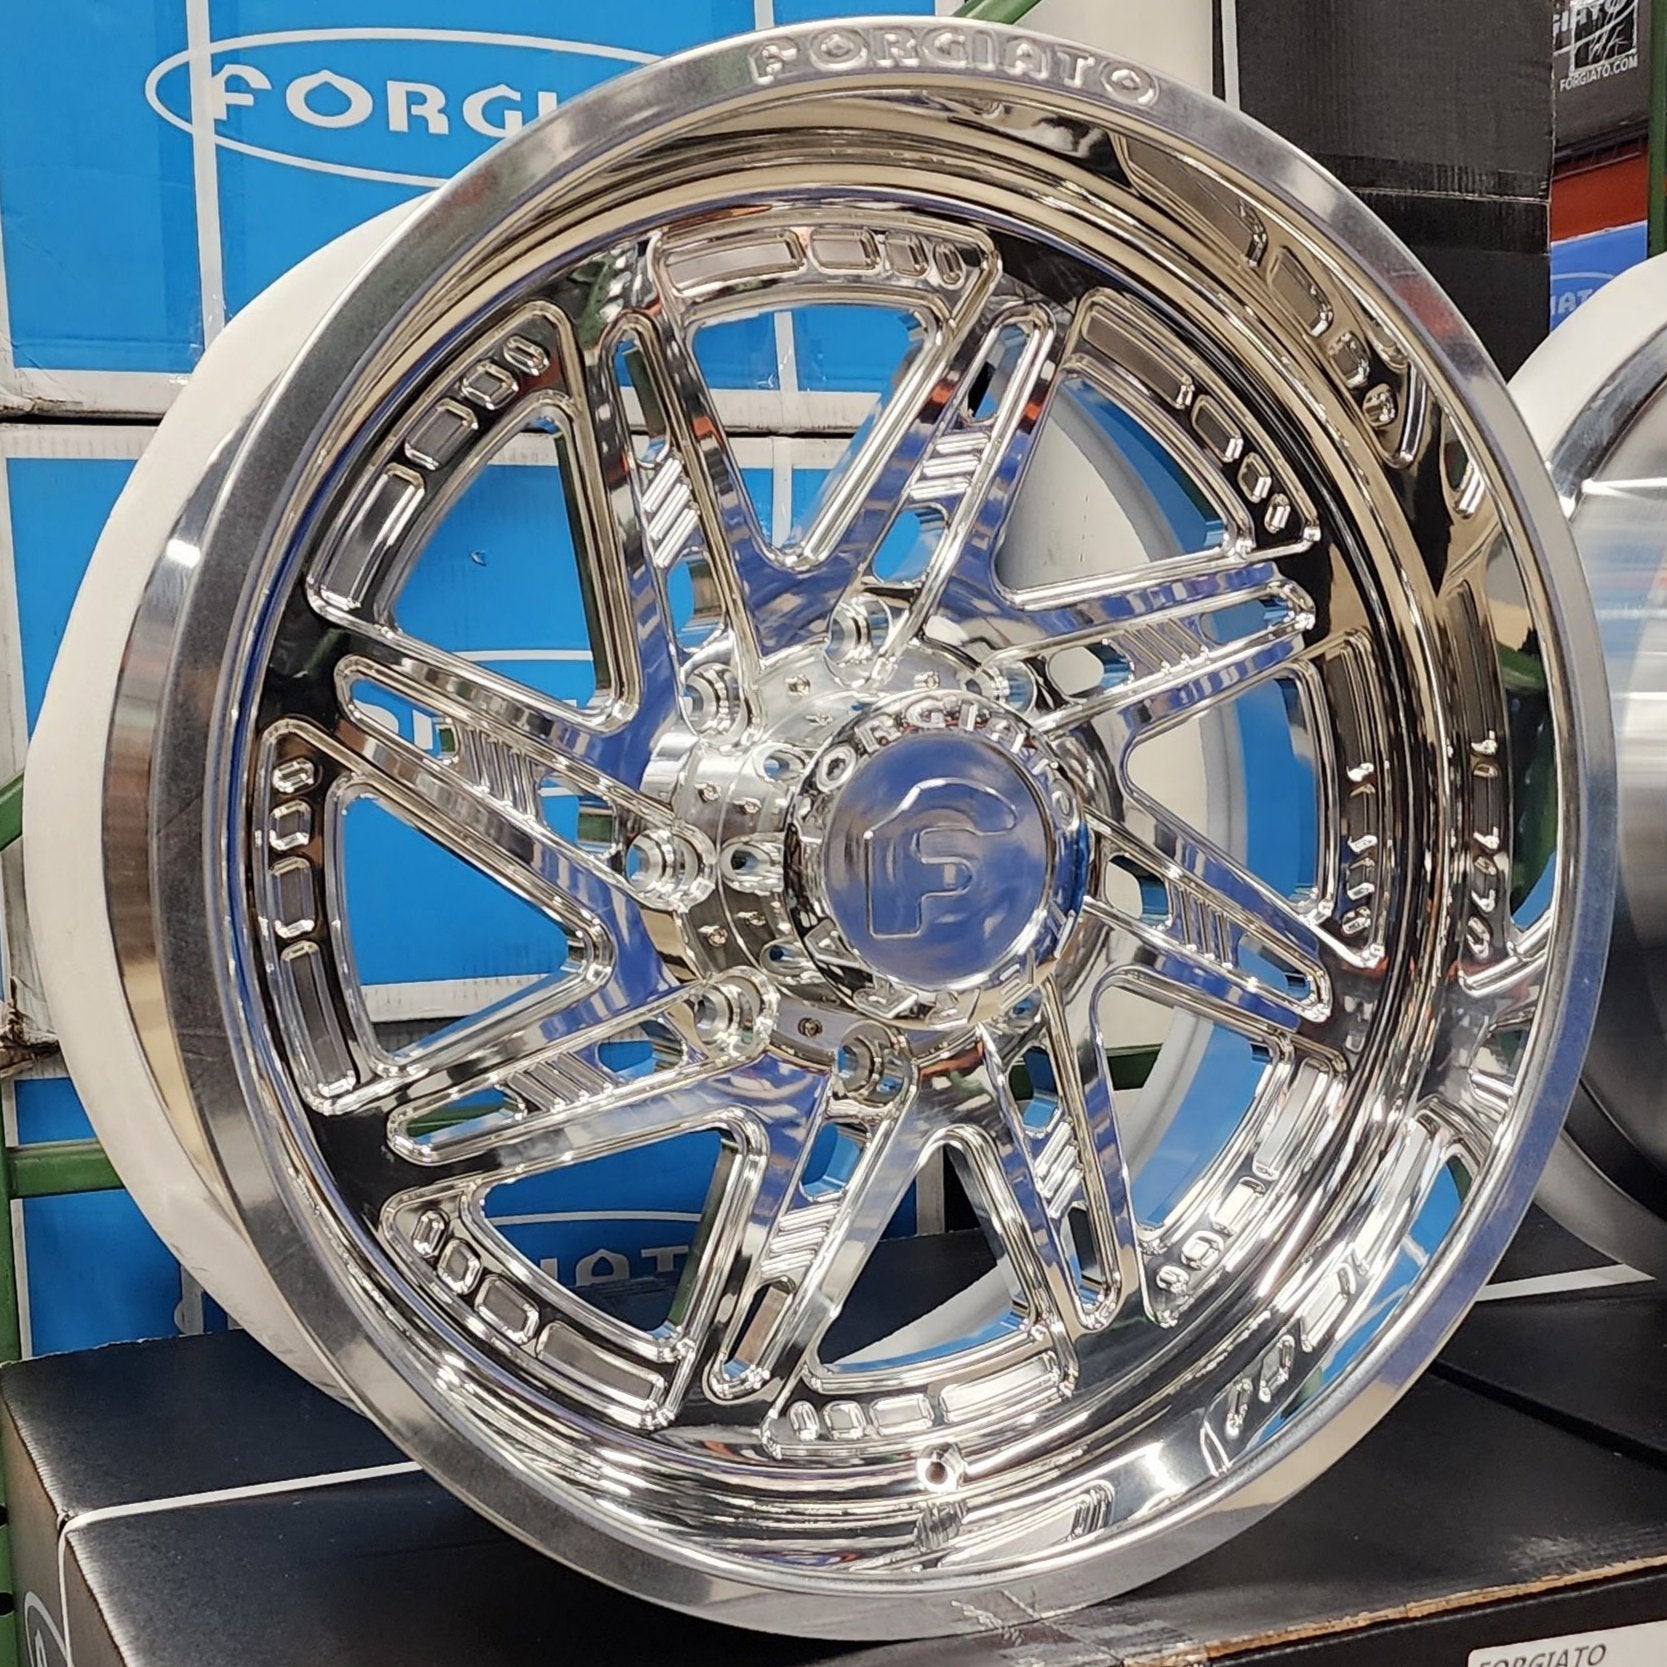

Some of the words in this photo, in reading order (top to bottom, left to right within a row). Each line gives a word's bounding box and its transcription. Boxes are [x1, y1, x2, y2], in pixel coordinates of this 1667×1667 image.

[748, 26, 1160, 107] FORGIATO
[1560, 54, 1638, 92] FORGIATO.COM
[1479, 1643, 1607, 1667] GIATO
